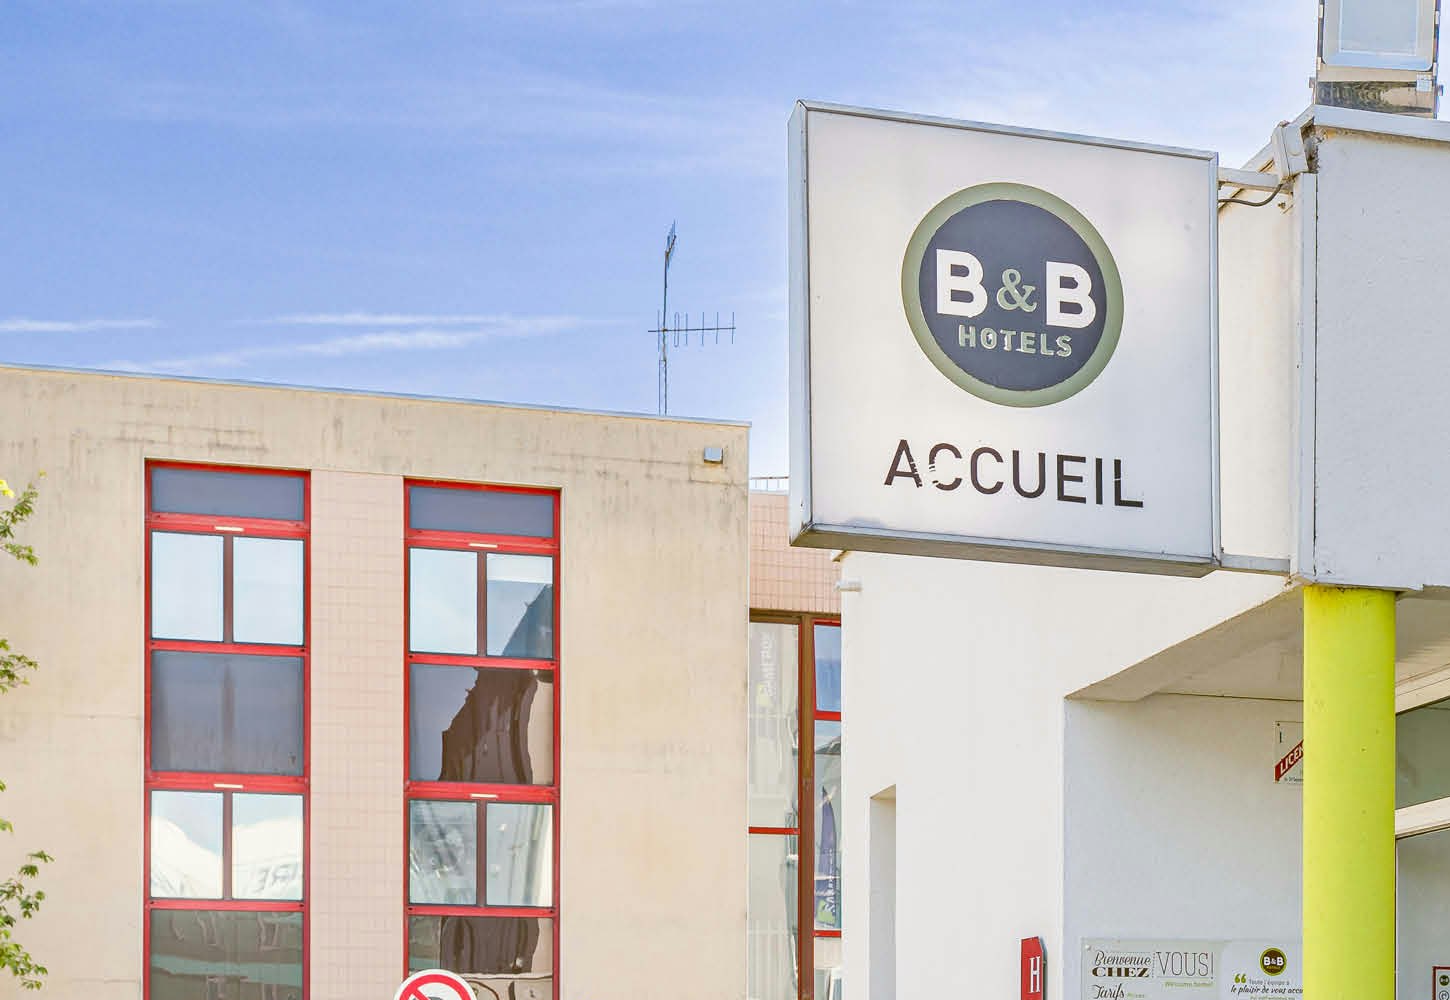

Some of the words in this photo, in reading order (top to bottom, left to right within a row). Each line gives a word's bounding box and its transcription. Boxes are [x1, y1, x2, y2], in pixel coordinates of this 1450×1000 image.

[958, 324, 1073, 357] HOTELS
[884, 439, 1144, 508] ACCUEIL
[1094, 950, 1152, 967] Bienvenue
[1092, 967, 1150, 978] CHEZ
[1237, 985, 1260, 996] plaisir
[1261, 985, 1269, 993] de
